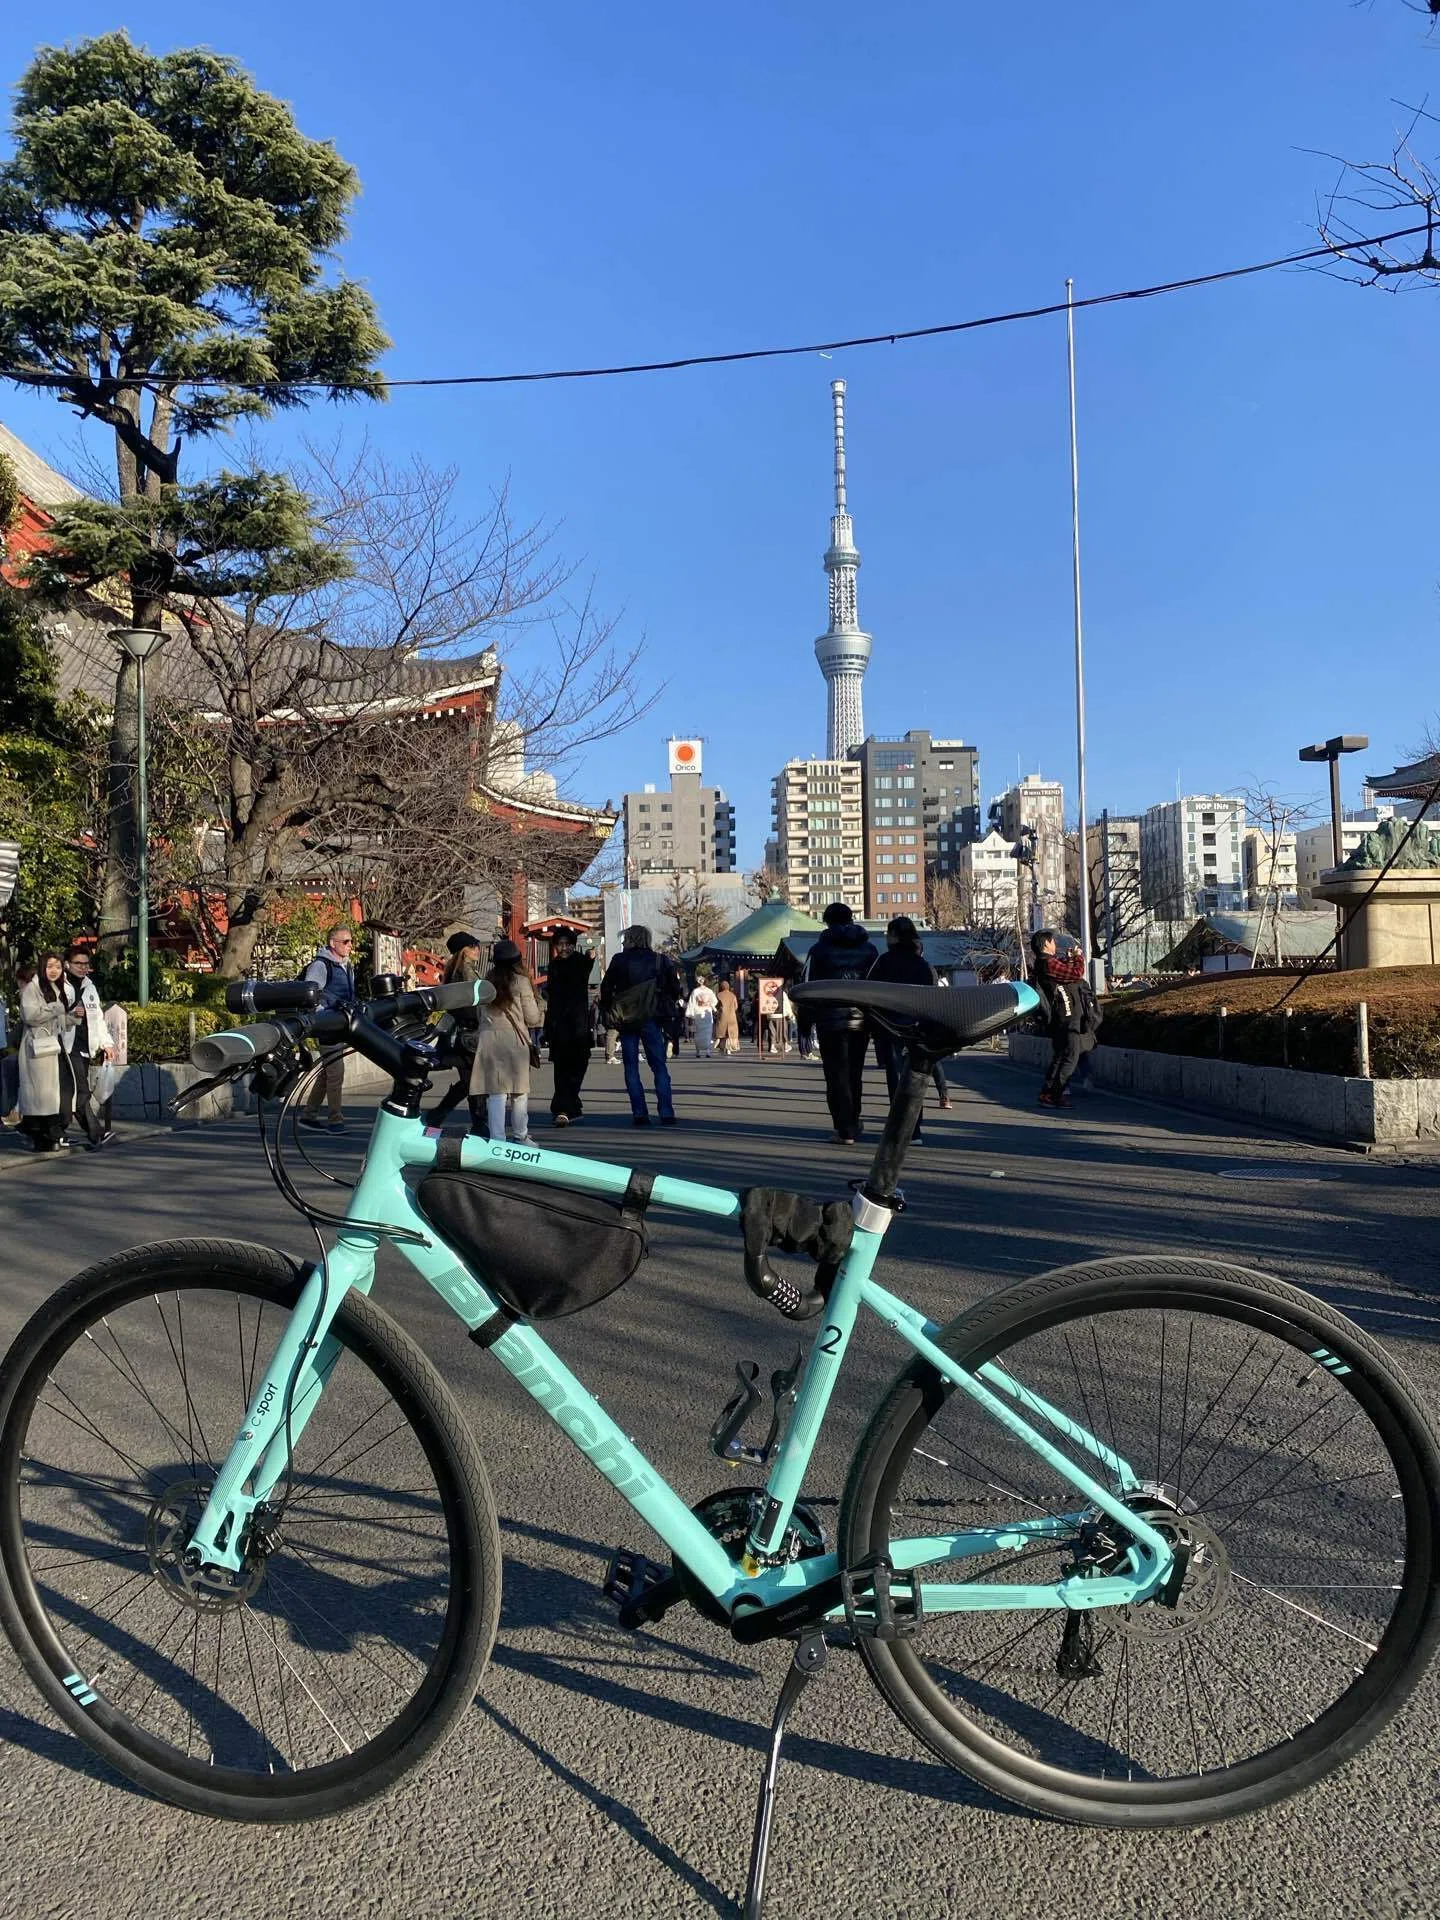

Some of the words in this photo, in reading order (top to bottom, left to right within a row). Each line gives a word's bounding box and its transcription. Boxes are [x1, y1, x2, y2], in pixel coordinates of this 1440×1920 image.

[1195, 802, 1212, 810] HOP
[1213, 802, 1229, 810] INN
[505, 1148, 541, 1163] sport
[819, 1324, 842, 1355] 2
[430, 1265, 655, 1499] Banchi
[256, 1382, 278, 1416] sport
